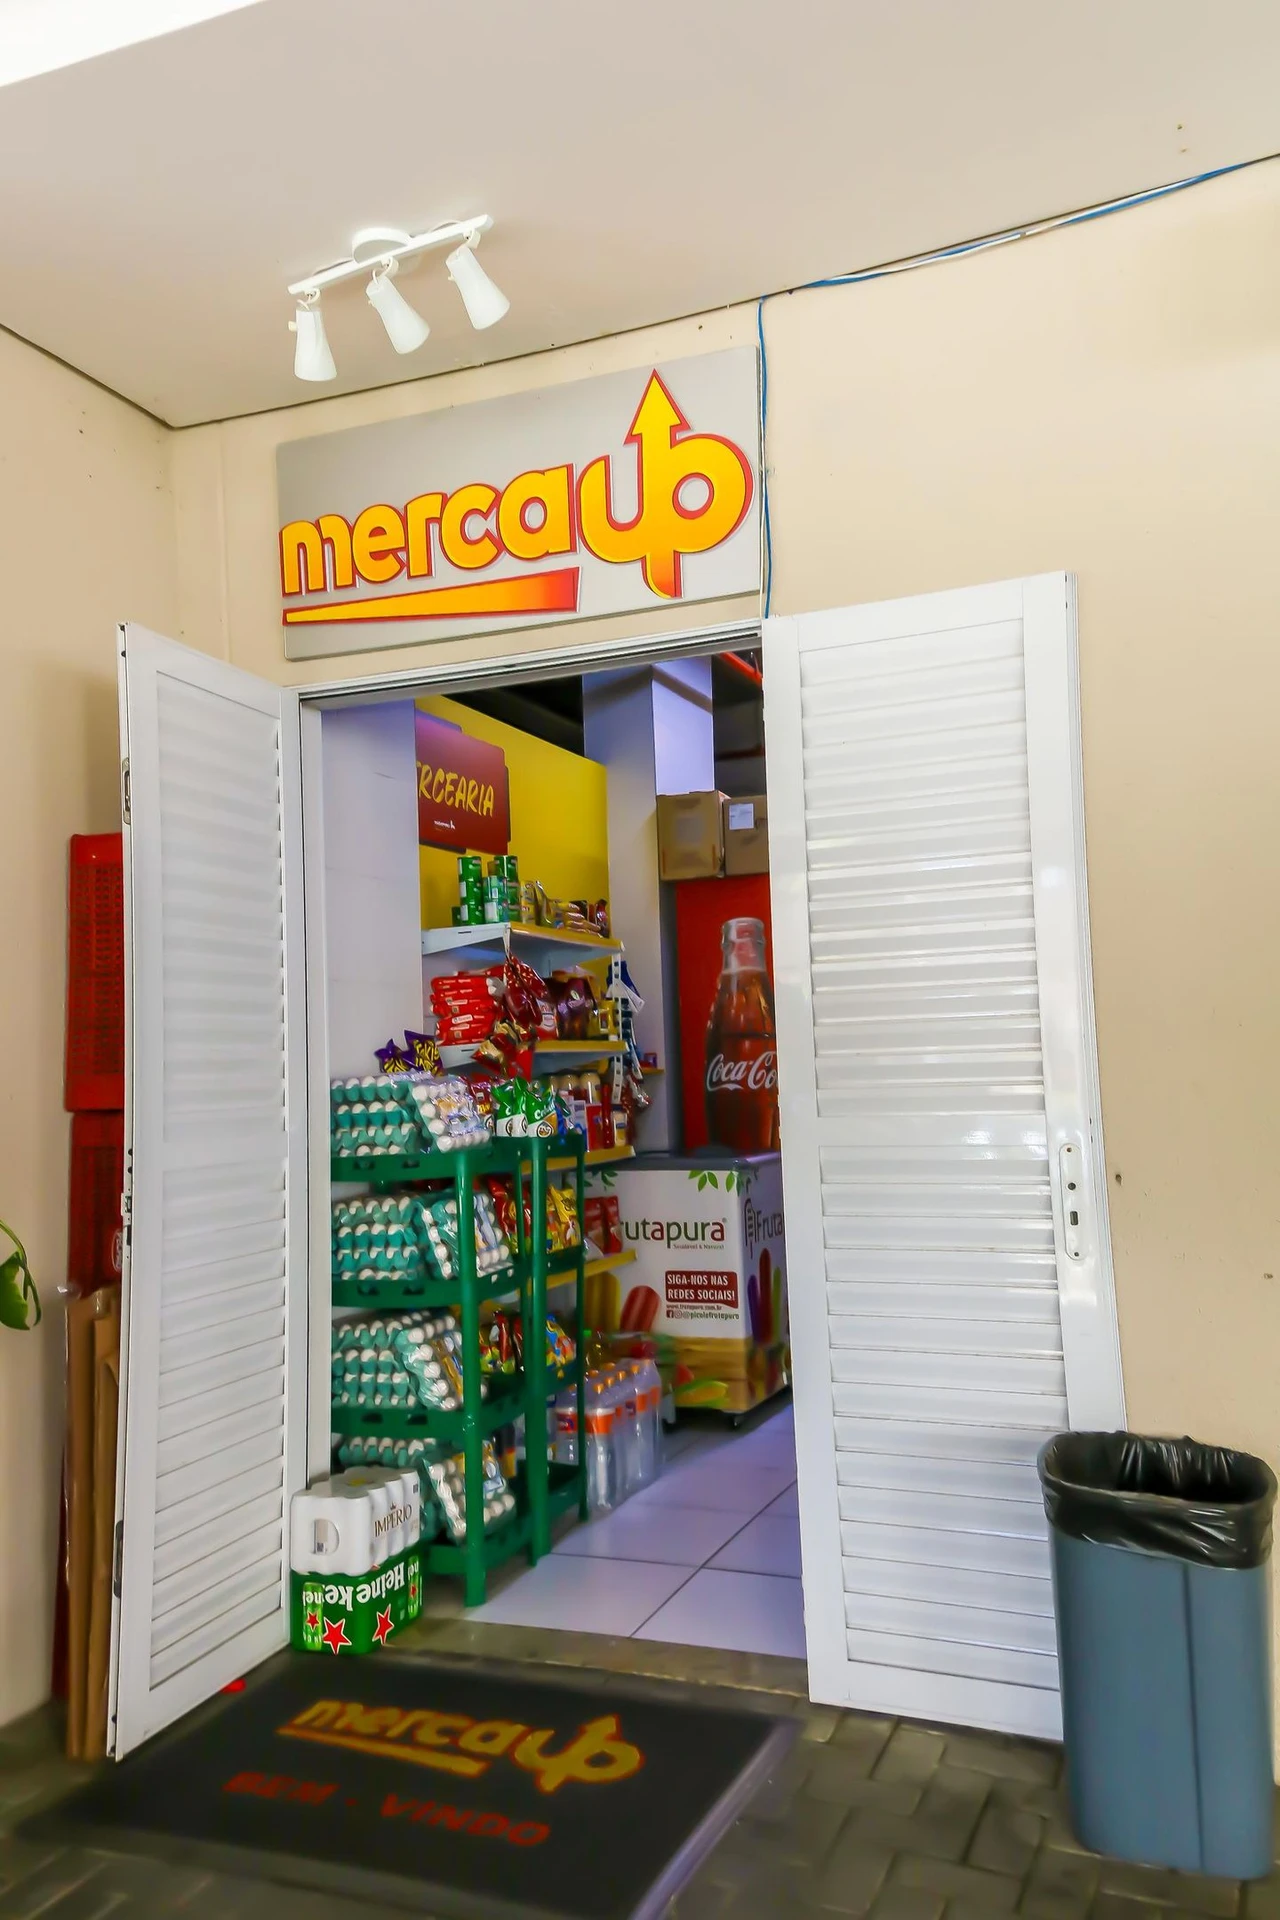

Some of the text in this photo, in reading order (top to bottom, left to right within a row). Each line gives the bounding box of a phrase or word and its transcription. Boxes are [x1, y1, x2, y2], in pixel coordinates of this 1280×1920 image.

[416, 761, 494, 818] RCEARIA
[706, 1051, 779, 1092] Coca-Co
[667, 1274, 728, 1286] SIGA-NOS NAS
[668, 1288, 735, 1301] REDES SOCIAIS!
[321, 1562, 405, 1611] Heineke
[222, 1771, 339, 1807] BEM
[379, 1793, 551, 1847] VINDO
